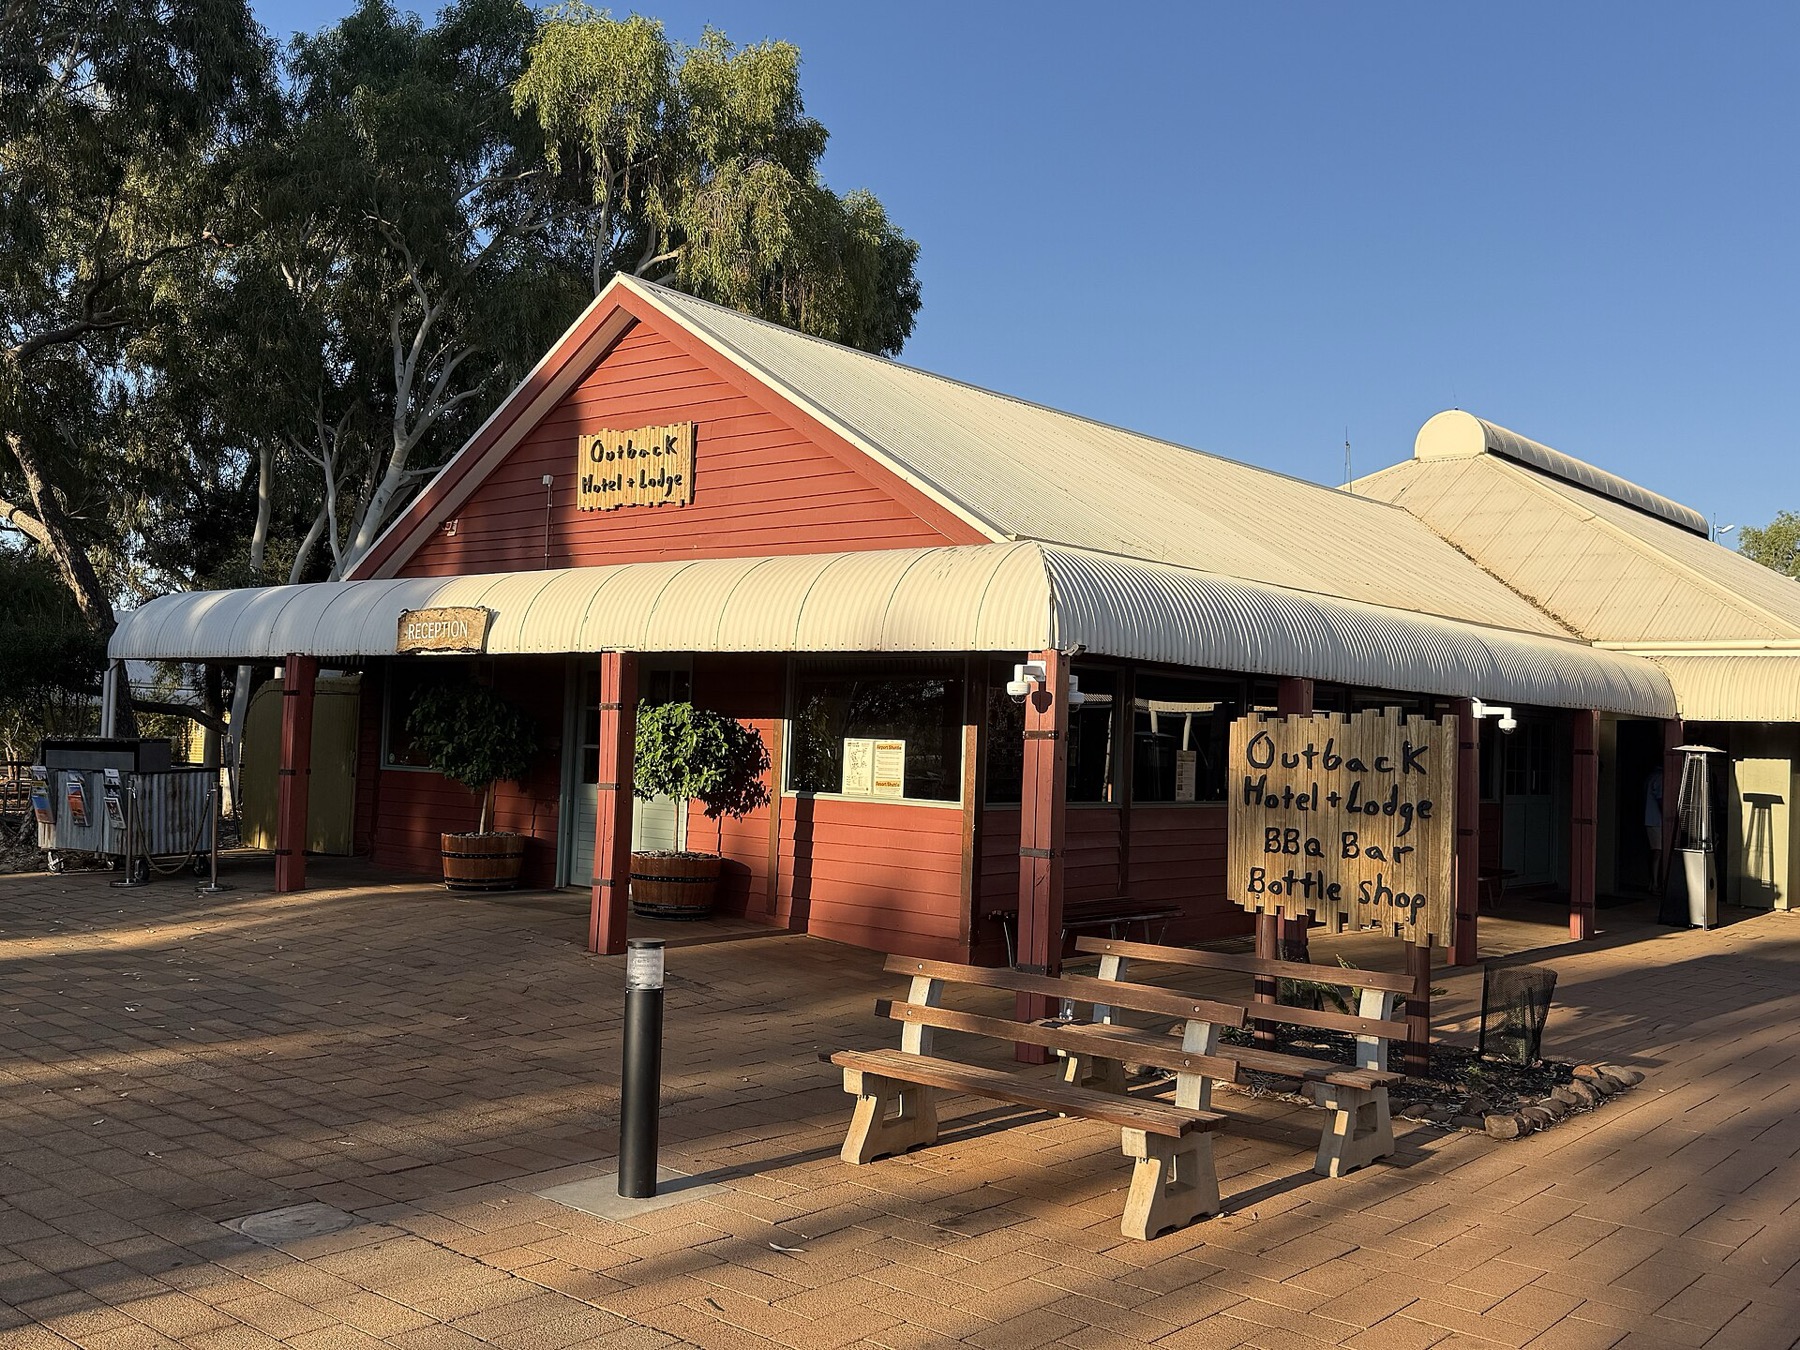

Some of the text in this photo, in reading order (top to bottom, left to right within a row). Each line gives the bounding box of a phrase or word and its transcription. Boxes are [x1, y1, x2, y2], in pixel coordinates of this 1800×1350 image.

[582, 473, 622, 495] Hotel
[639, 467, 683, 497] Lodge
[408, 620, 468, 640] RECEPTION
[1244, 774, 1318, 811] Hotel
[1345, 781, 1433, 837] Lodge
[1341, 831, 1414, 864] Bar
[1247, 866, 1342, 901] Bottle
